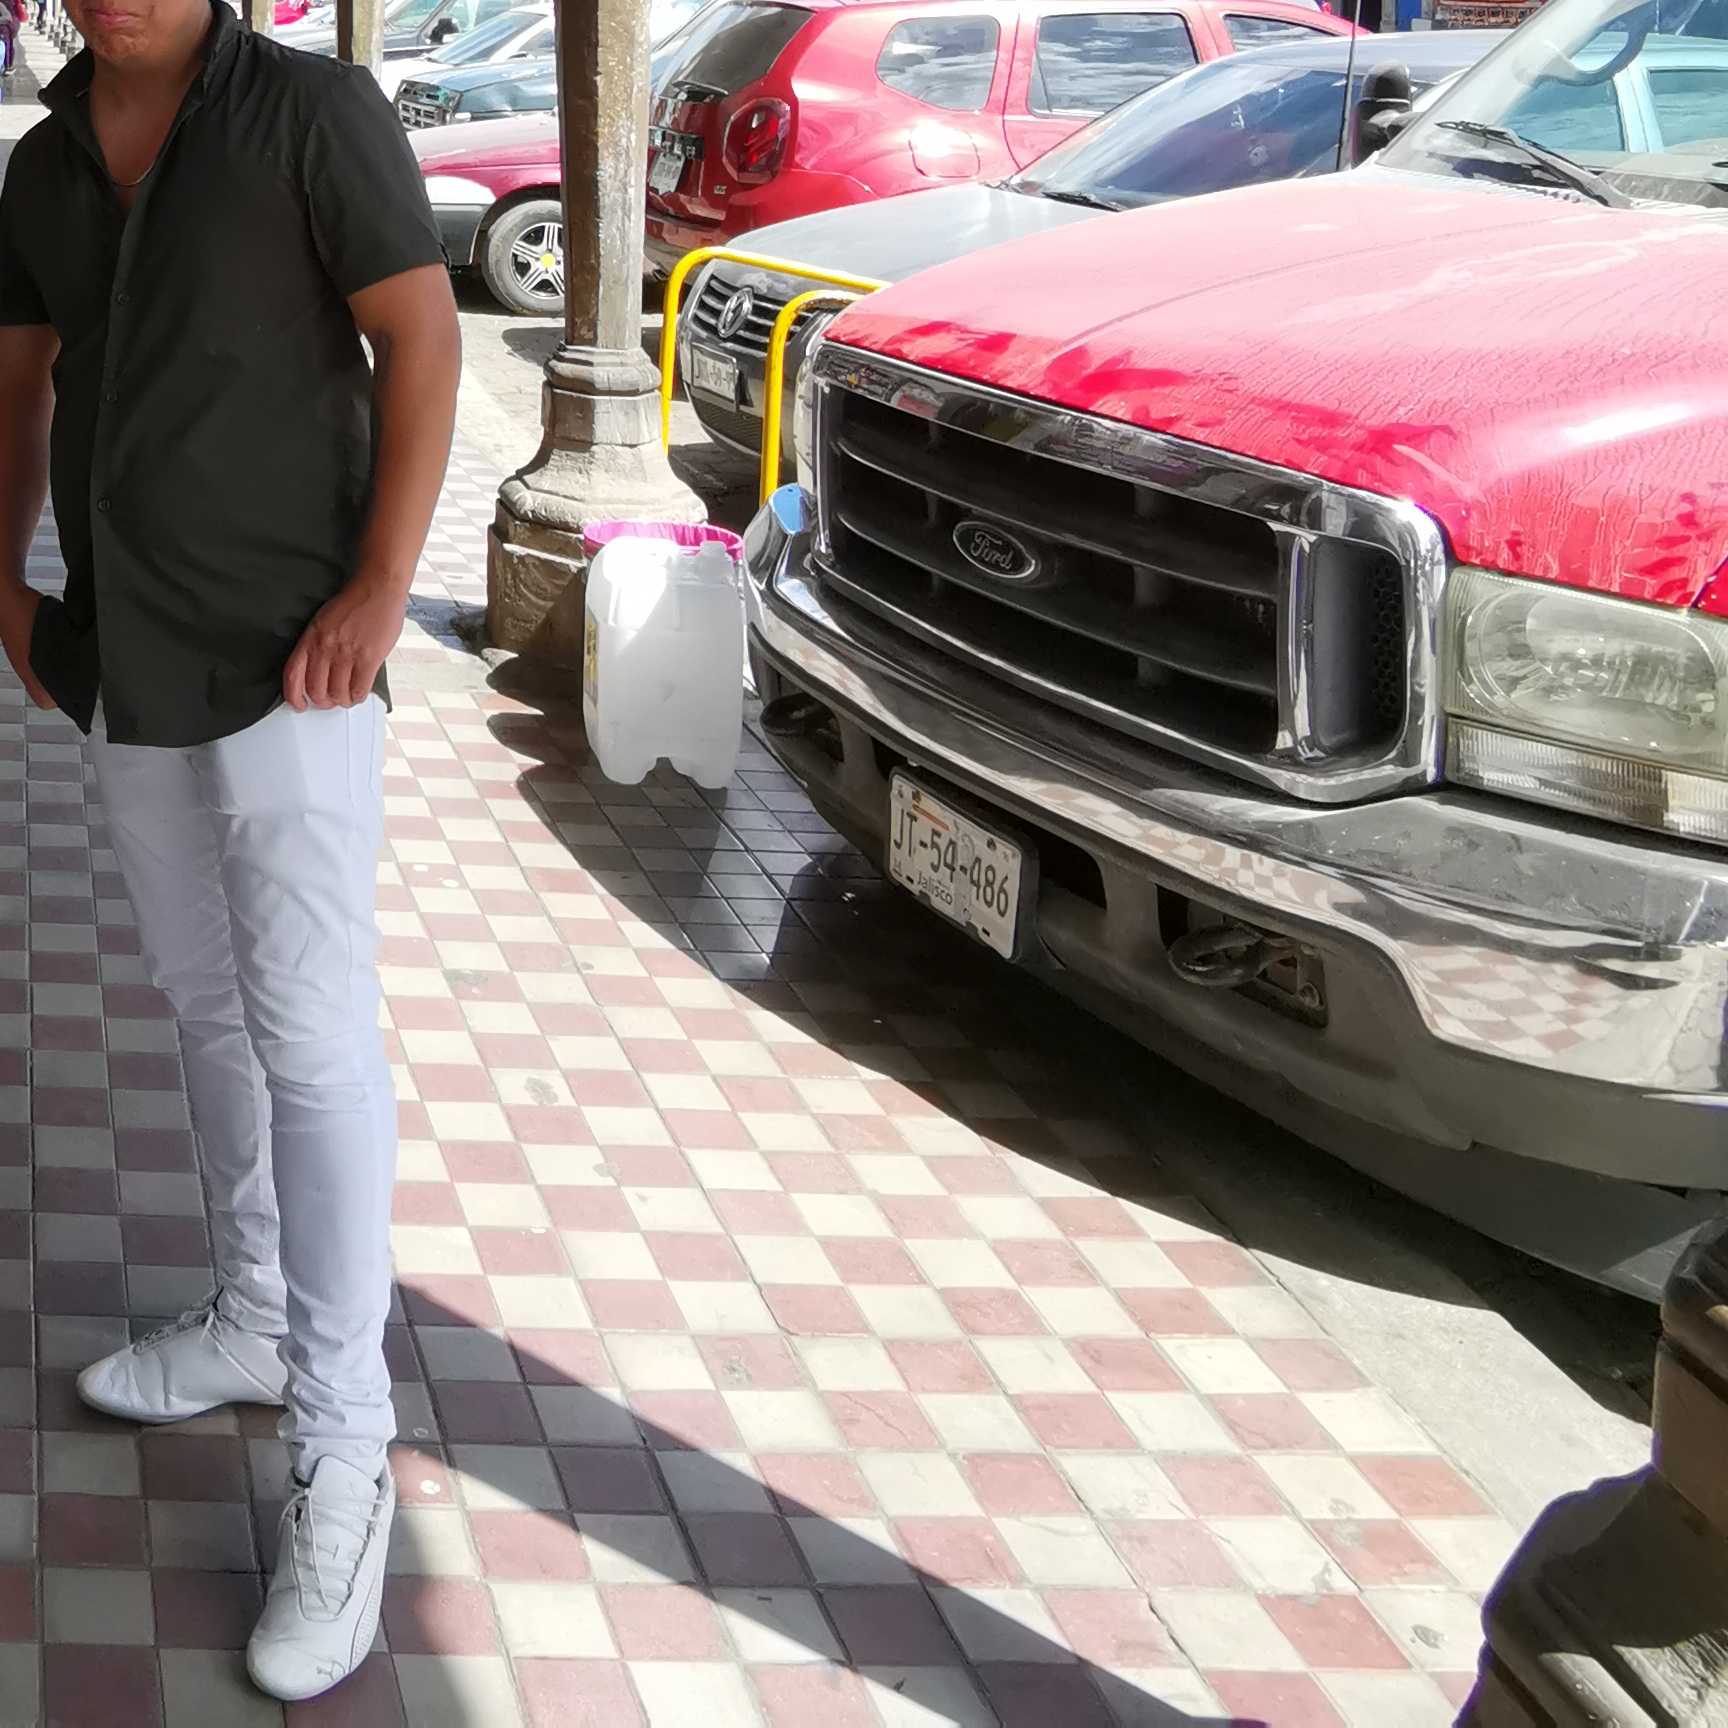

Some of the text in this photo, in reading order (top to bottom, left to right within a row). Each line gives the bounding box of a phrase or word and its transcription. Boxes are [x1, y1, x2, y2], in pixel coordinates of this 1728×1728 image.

[970, 531, 1013, 569] Ford
[893, 808, 1009, 919] JT-54-486
[916, 870, 953, 906] Jalisco
